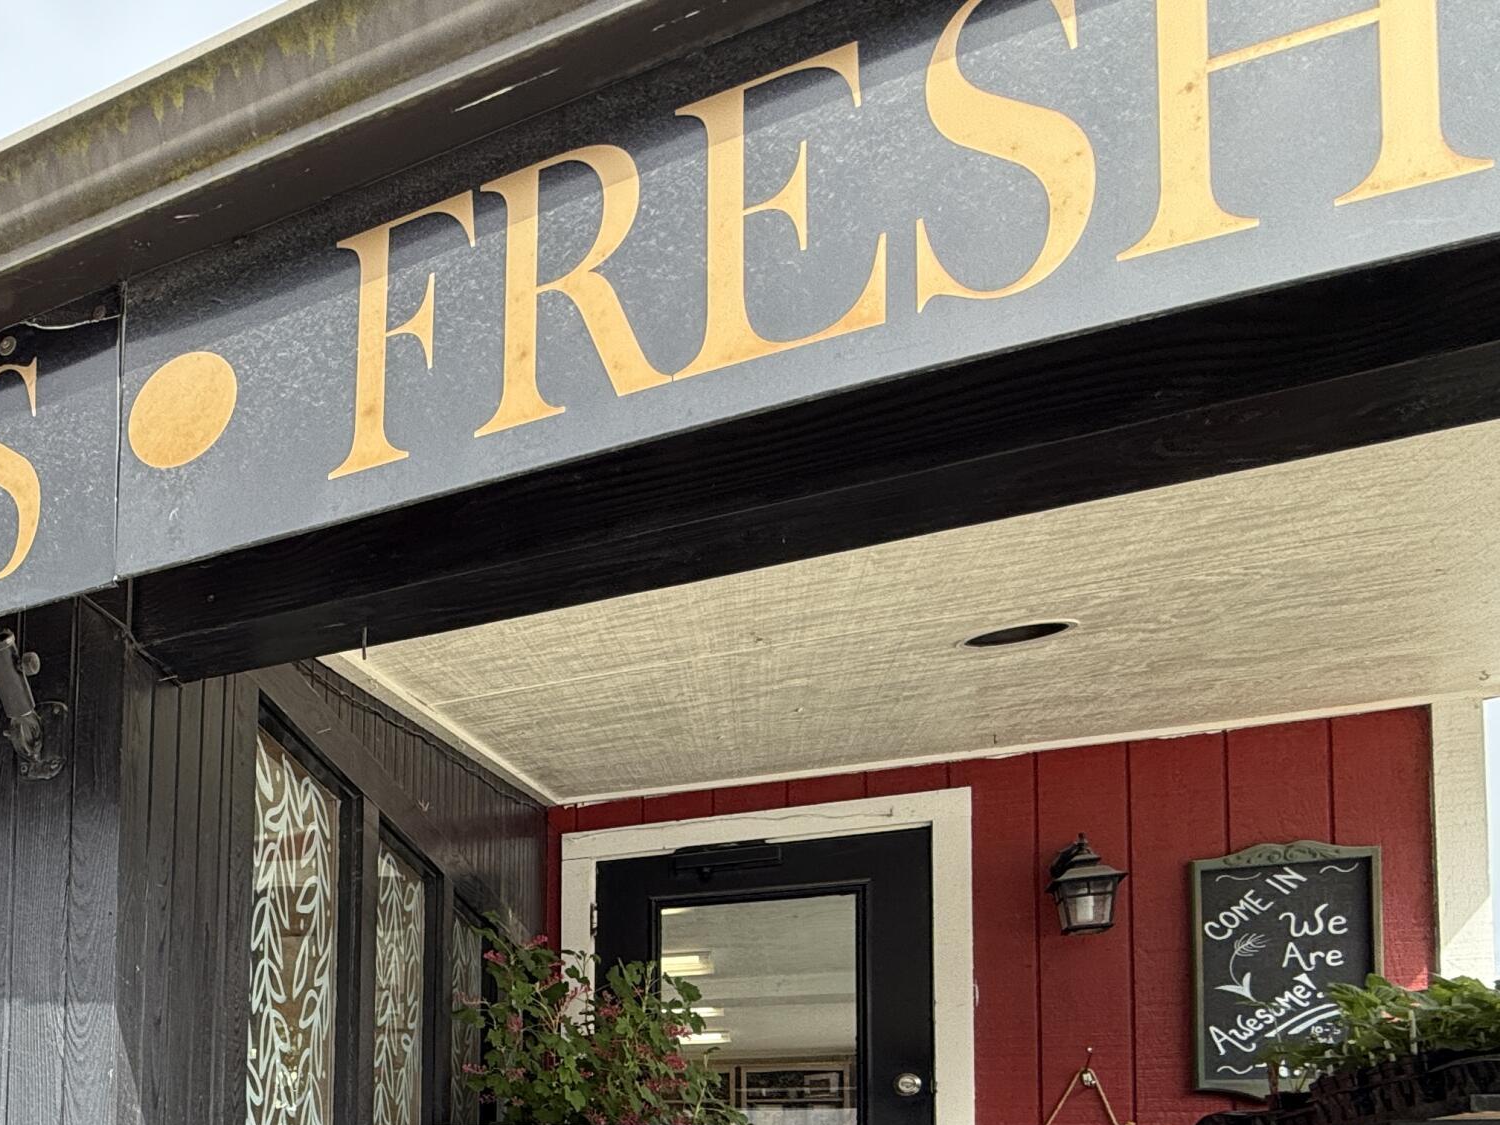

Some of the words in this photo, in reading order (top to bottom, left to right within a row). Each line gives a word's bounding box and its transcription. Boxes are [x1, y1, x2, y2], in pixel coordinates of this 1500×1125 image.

[327, 0, 1496, 480] FRESH
[1203, 889, 1275, 941] COME
[1265, 866, 1308, 895] IN
[1278, 903, 1349, 938] We
[1281, 941, 1345, 972] Are
